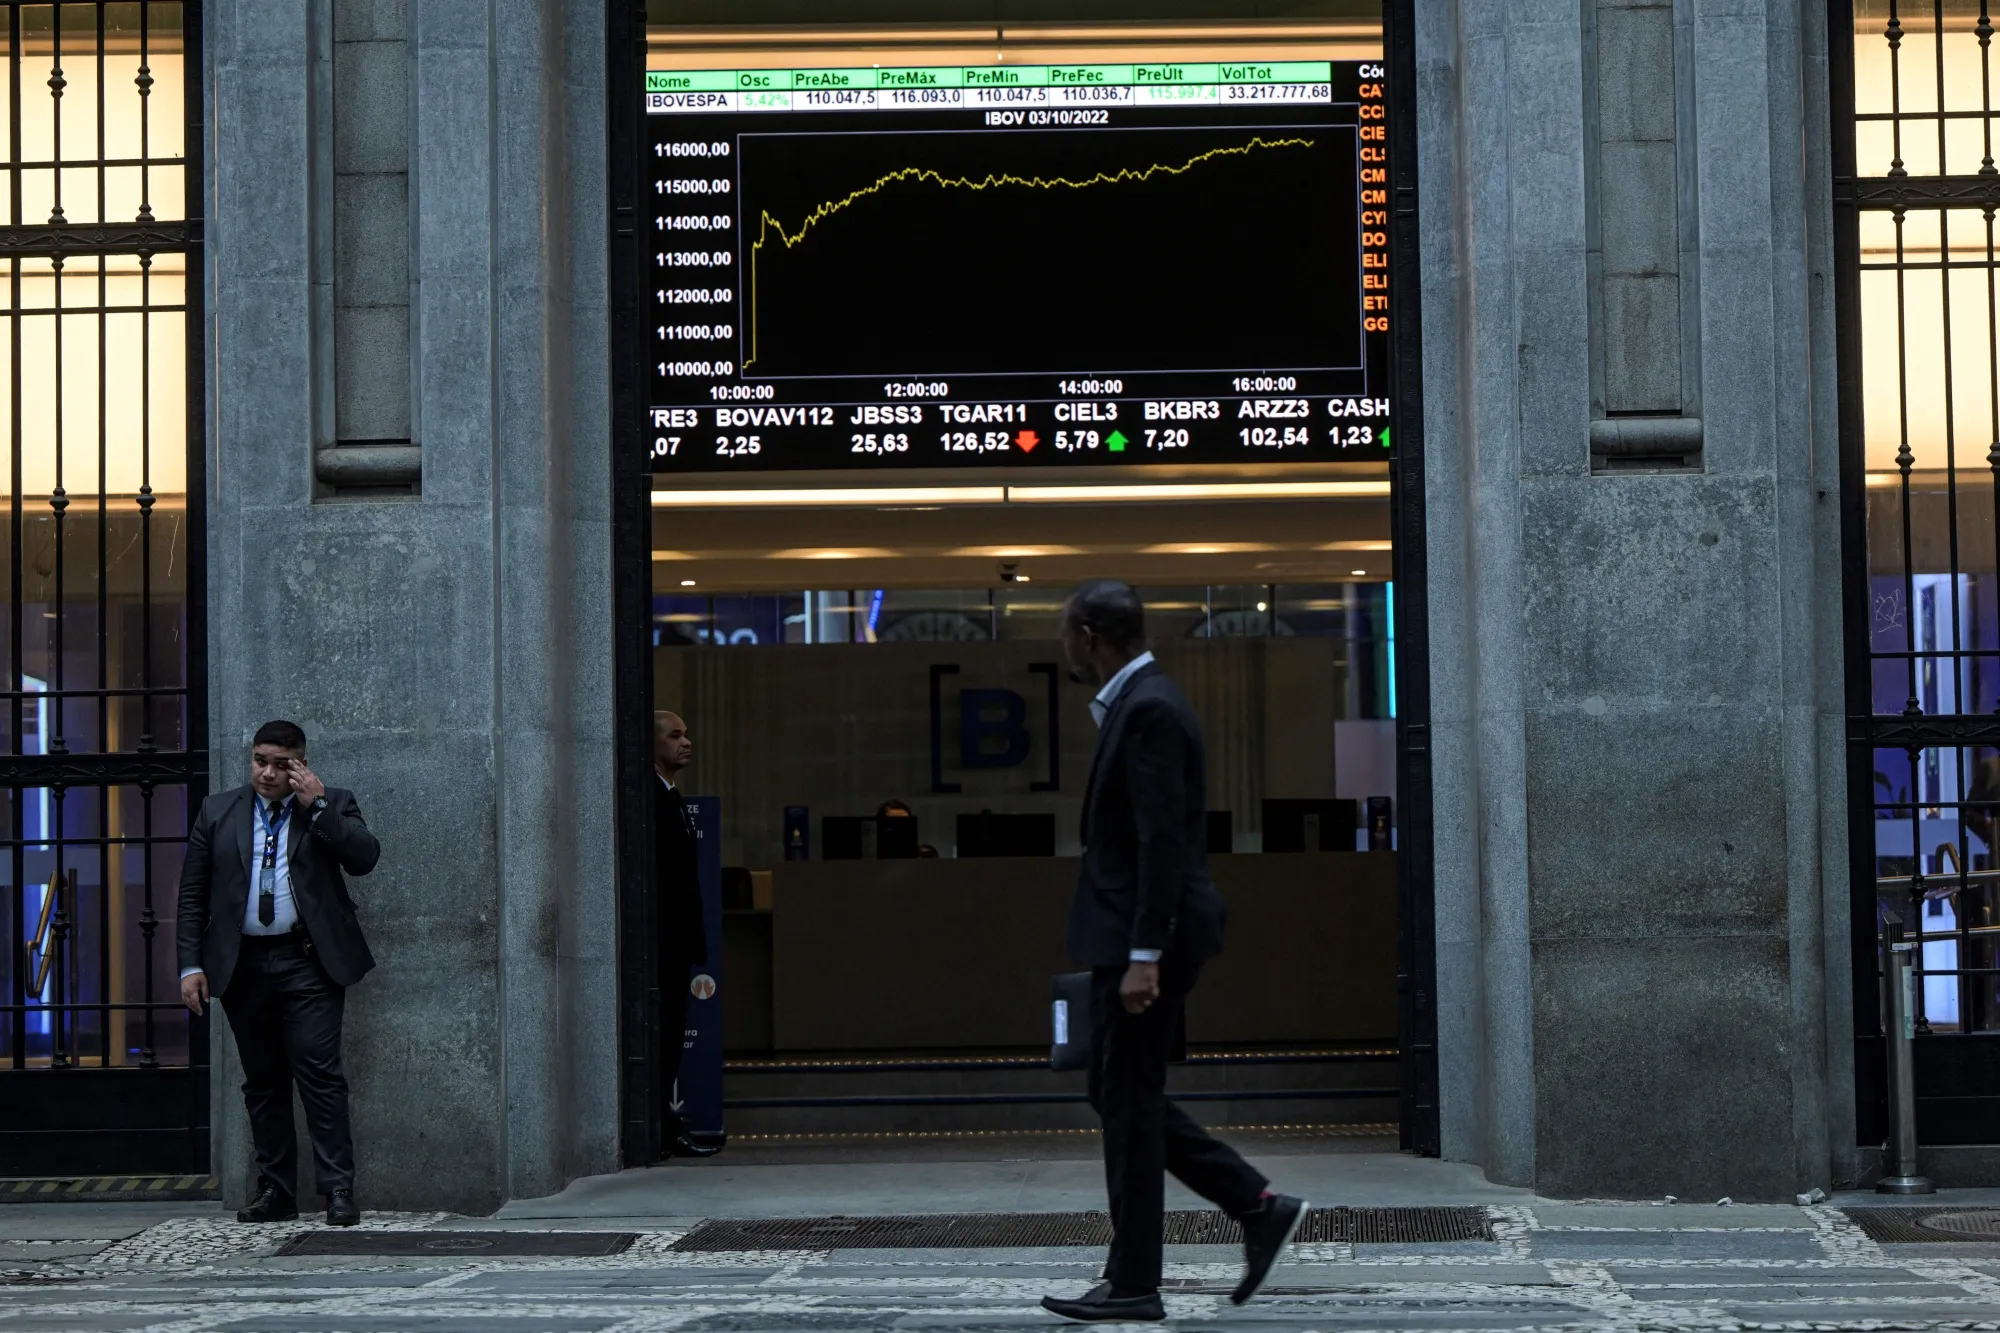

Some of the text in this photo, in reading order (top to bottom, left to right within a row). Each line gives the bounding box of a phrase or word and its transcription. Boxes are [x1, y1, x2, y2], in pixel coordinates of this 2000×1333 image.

[649, 76, 690, 87] Nome
[741, 75, 769, 86] Osc
[796, 73, 848, 85] PreAbe
[882, 72, 935, 84] PreMáx
[1052, 70, 1103, 82] PreFec
[1223, 67, 1271, 79] VolTot
[648, 95, 727, 107] IBOVESPA
[745, 93, 789, 107] 5,42%
[807, 90, 875, 104] 110.047,5
[892, 89, 960, 103] 116.093,0
[978, 88, 1046, 102] 110.047,5
[1063, 87, 1131, 101] 110.036,7
[1228, 86, 1328, 99] 33.217.777,68
[986, 110, 1108, 125] IBOV 03/10/2022
[1359, 105, 1384, 118] CC
[655, 142, 729, 157] 116000,00
[656, 179, 730, 194] 115000,00
[656, 215, 730, 230] 114000,00
[1362, 232, 1386, 246] DO
[657, 252, 731, 267] 113000,00
[657, 289, 732, 304] 112000,00
[658, 325, 732, 340] 111000,00
[658, 361, 733, 376] 110000,00
[710, 377, 1296, 399] 10:00:00 12:00:00 14:00:00 16:00:00
[717, 407, 833, 426] BOVAV112
[851, 406, 922, 424] JBSS3
[940, 404, 1025, 423] TGAR11
[1055, 403, 1117, 421] CIEL3
[1145, 401, 1220, 420] BKBR3
[1238, 400, 1309, 418] ARZZ3
[1328, 398, 1389, 417] CASH
[716, 436, 760, 457] 2,25
[852, 434, 908, 455] 25,63
[941, 432, 1009, 453] 126,52
[1055, 431, 1099, 452] 5,79
[1145, 429, 1188, 450] 7,20
[1240, 427, 1309, 449] 102,54
[1329, 426, 1372, 447] 1,23
